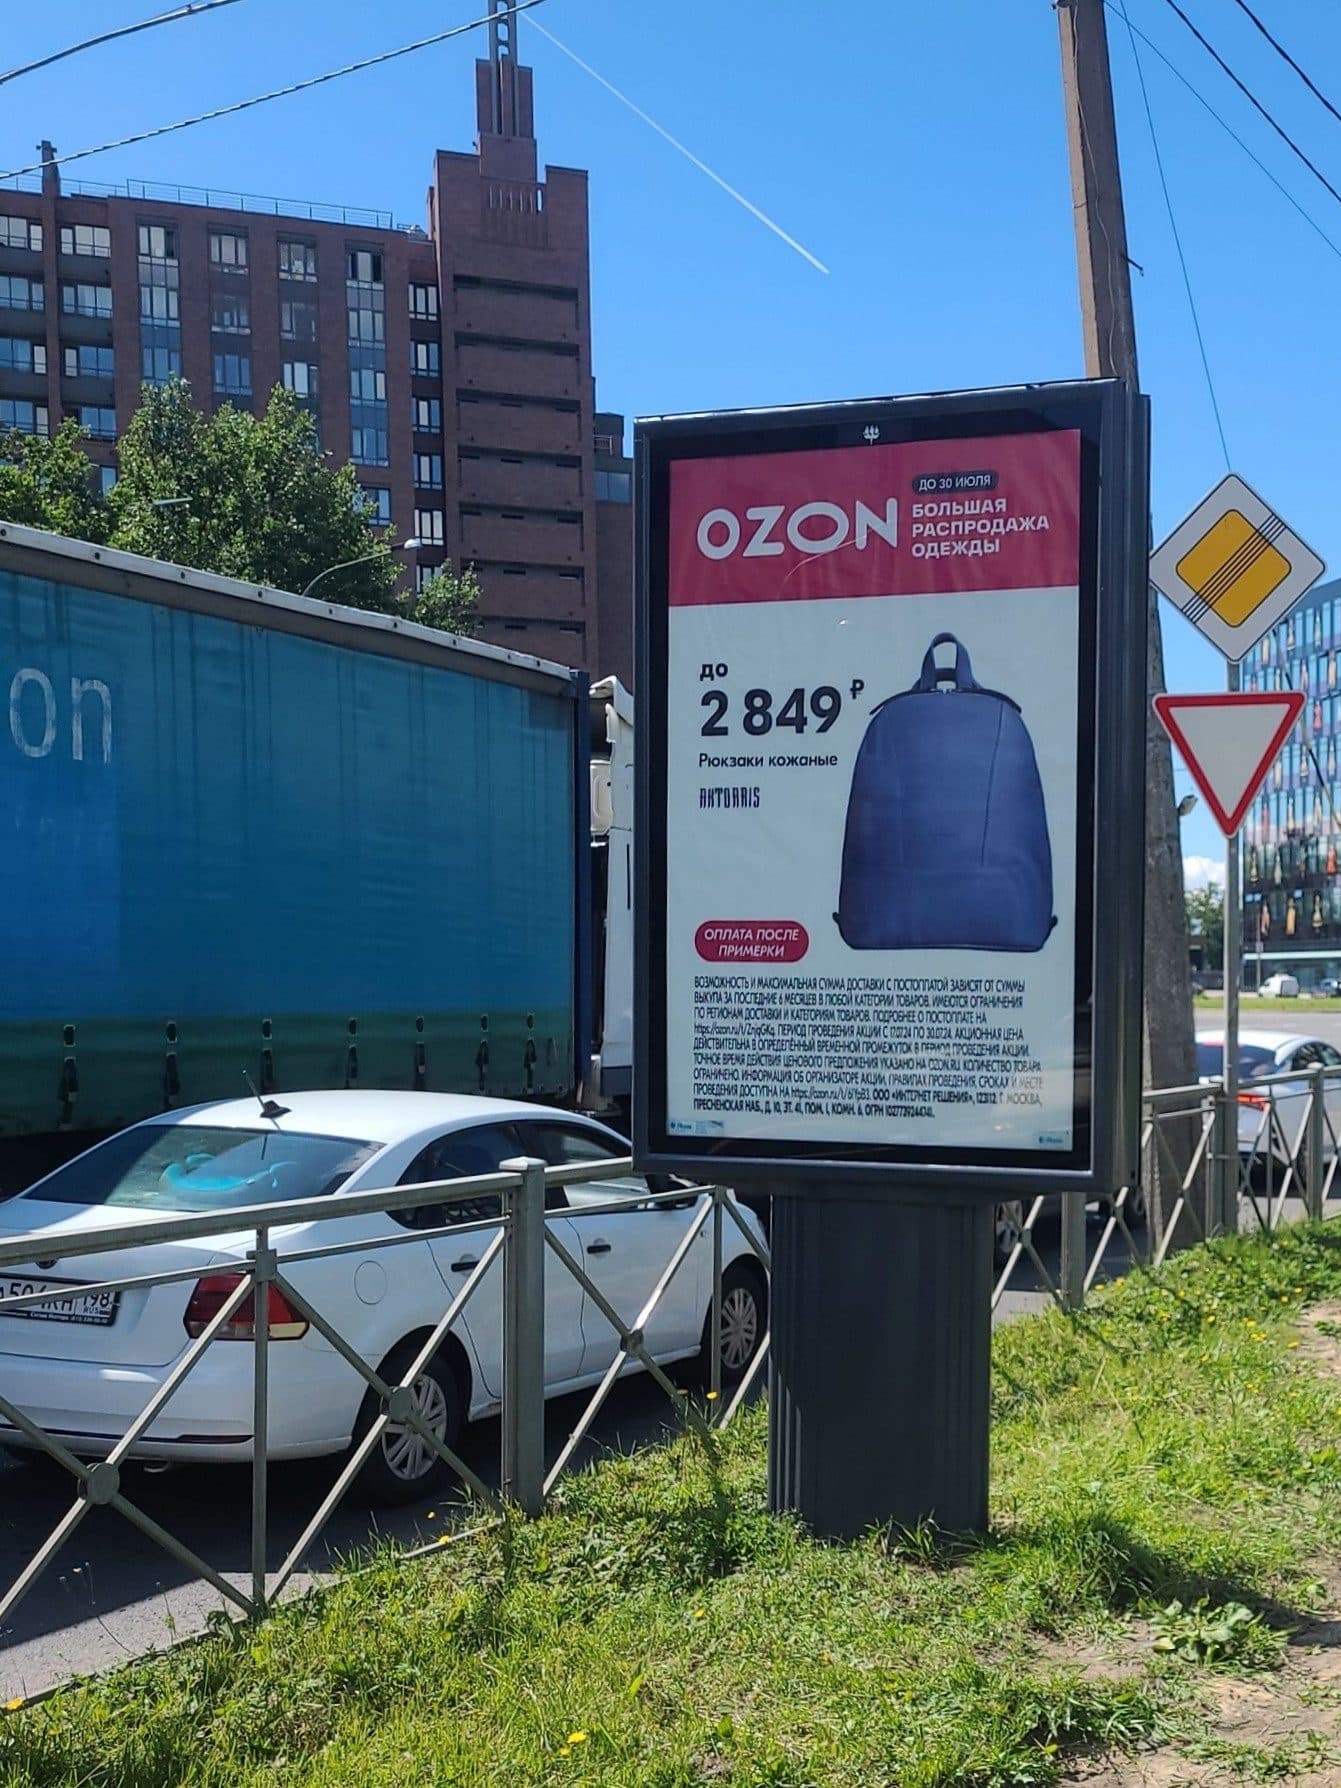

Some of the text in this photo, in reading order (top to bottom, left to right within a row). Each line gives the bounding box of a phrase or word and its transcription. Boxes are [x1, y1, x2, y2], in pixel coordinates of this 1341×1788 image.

[919, 475, 992, 491] ДО 30 ИЮЛЯ
[912, 498, 1007, 518] БОЛЬШАЯ
[697, 498, 899, 560] OZON
[912, 515, 1050, 537] РАСПРОДАЖА
[911, 539, 1000, 559] ОДЕЖДЫ
[700, 663, 729, 681] до
[699, 753, 838, 768] Рюкзаки кожаные
[704, 929, 799, 940] ОПЛАТА ПОСЛЕ
[719, 945, 785, 956] ПРИМЕРКИ
[694, 976, 749, 989] ВОЗМОЖНОСТЬ
[757, 977, 816, 990] МАКСИМАЛЬНАЯ
[819, 977, 845, 990] СУММА
[847, 978, 885, 991] ДОСТАВКИ
[894, 978, 948, 991] ПОСТОПЛАТОЙ
[950, 979, 982, 992] ЗАВИСЯТ
[996, 979, 1025, 992] СУММЫ
[694, 991, 722, 1004] ВЫКУПА
[734, 992, 777, 1005] ПОСЛЕДНИЕ
[785, 993, 816, 1005] МЕСЯЦЕВ
[825, 993, 853, 1006] ЛЮБОЙ
[855, 994, 894, 1006] КАТЕГОРИИ
[932, 995, 968, 1008] ИМЕЮТСЯ
[970, 995, 1023, 1008] ОГРАНИЧЕНИЯ
[694, 1007, 704, 1019] ПО
[707, 1007, 743, 1019] РЕГИОНАМ
[745, 1008, 781, 1020] ДОСТАВКИ
[791, 1009, 835, 1021] КАТЕГОРИЯМ
[873, 1010, 915, 1022] ПОДРОБНЕЕ
[926, 1011, 973, 1024] ПОСТОПЛАТЕ
[976, 1012, 987, 1024] НА
[778, 1024, 806, 1037] ПЕРИОД
[809, 1025, 854, 1038] ПРОВЕДЕНИЯ
[856, 1025, 881, 1038] АКЦИИ
[914, 1026, 924, 1039] ПО
[955, 1027, 1001, 1040] АКЦИОННАЯ
[1003, 1028, 1024, 1040] ЦЕНА
[694, 1038, 750, 1051] ДЕЙСТВИТЕЛЬНА
[817, 1040, 860, 1053] ВРЕМЕННОЙ
[862, 1041, 912, 1054] ПРОМЕЖУТОК
[921, 1042, 951, 1055] ПЕРИОД
[953, 1042, 999, 1056] ПРОВЕДЕНИЯ
[694, 1053, 721, 1065] ТОЧНОЕ
[723, 1053, 745, 1066] ВРЕМЯ
[747, 1054, 781, 1067] ДЕЙСТВИЯ
[783, 1055, 822, 1068] ЦЕНОВОГО
[825, 1056, 878, 1069] ПРЕДЛОЖЕНИЯ
[881, 1057, 913, 1070] УКАЗАНО
[916, 1057, 926, 1070] НА
[963, 1058, 1012, 1072] КОЛИЧЕСТВО
[1014, 1059, 1041, 1072] ТОВАРА
[742, 1069, 791, 1082] ИНФОРМАЦИЯ
[794, 1070, 804, 1083] ОБ
[806, 1070, 859, 1084] ОРГАНИЗАТОРЕ
[889, 1072, 926, 1086] ПРАВИЛАХ
[979, 1075, 1009, 1088] СРОКАХ
[694, 1083, 738, 1097] ПРОВЕДЕНИЯ
[740, 1084, 778, 1098] ДОСТУПНА
[873, 1088, 889, 1101] ООО
[694, 1099, 743, 1112] ПРЕСНЕНСКАЯ
[865, 1104, 884, 1116] ОГРН
